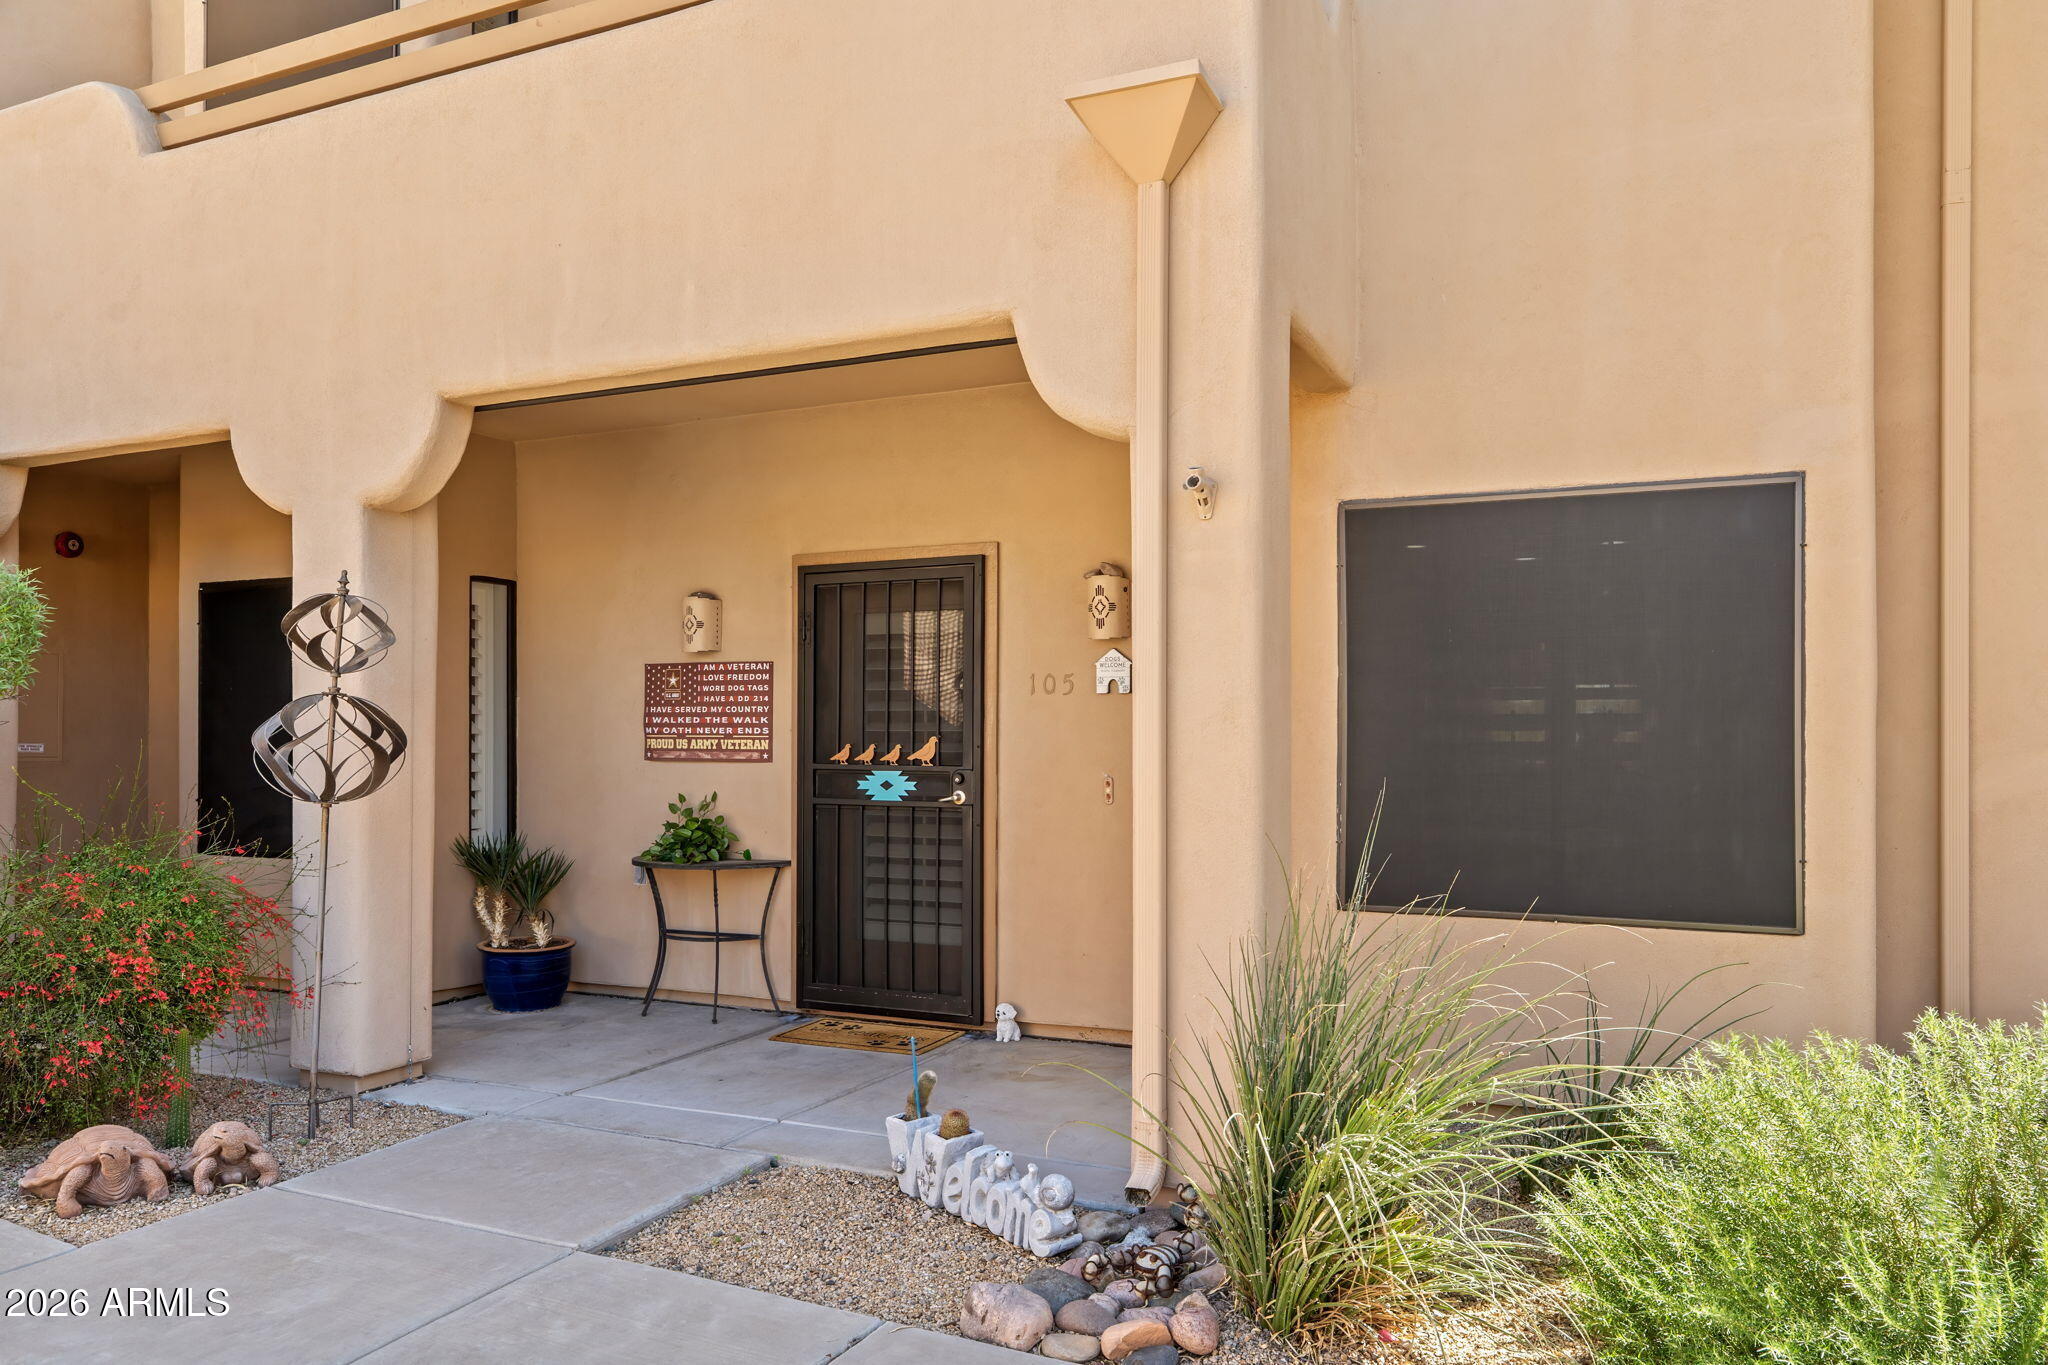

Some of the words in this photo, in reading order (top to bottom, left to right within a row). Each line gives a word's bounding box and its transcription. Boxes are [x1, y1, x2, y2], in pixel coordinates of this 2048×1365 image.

[703, 663, 716, 671] AM
[718, 663, 725, 671] A
[727, 662, 770, 671] VETERAN
[727, 673, 770, 681] FREEDOM
[1030, 673, 1074, 696] 105
[646, 739, 674, 749] PROUD
[676, 739, 688, 749] US
[690, 739, 718, 749] ARMY
[720, 740, 769, 750] VETERAN
